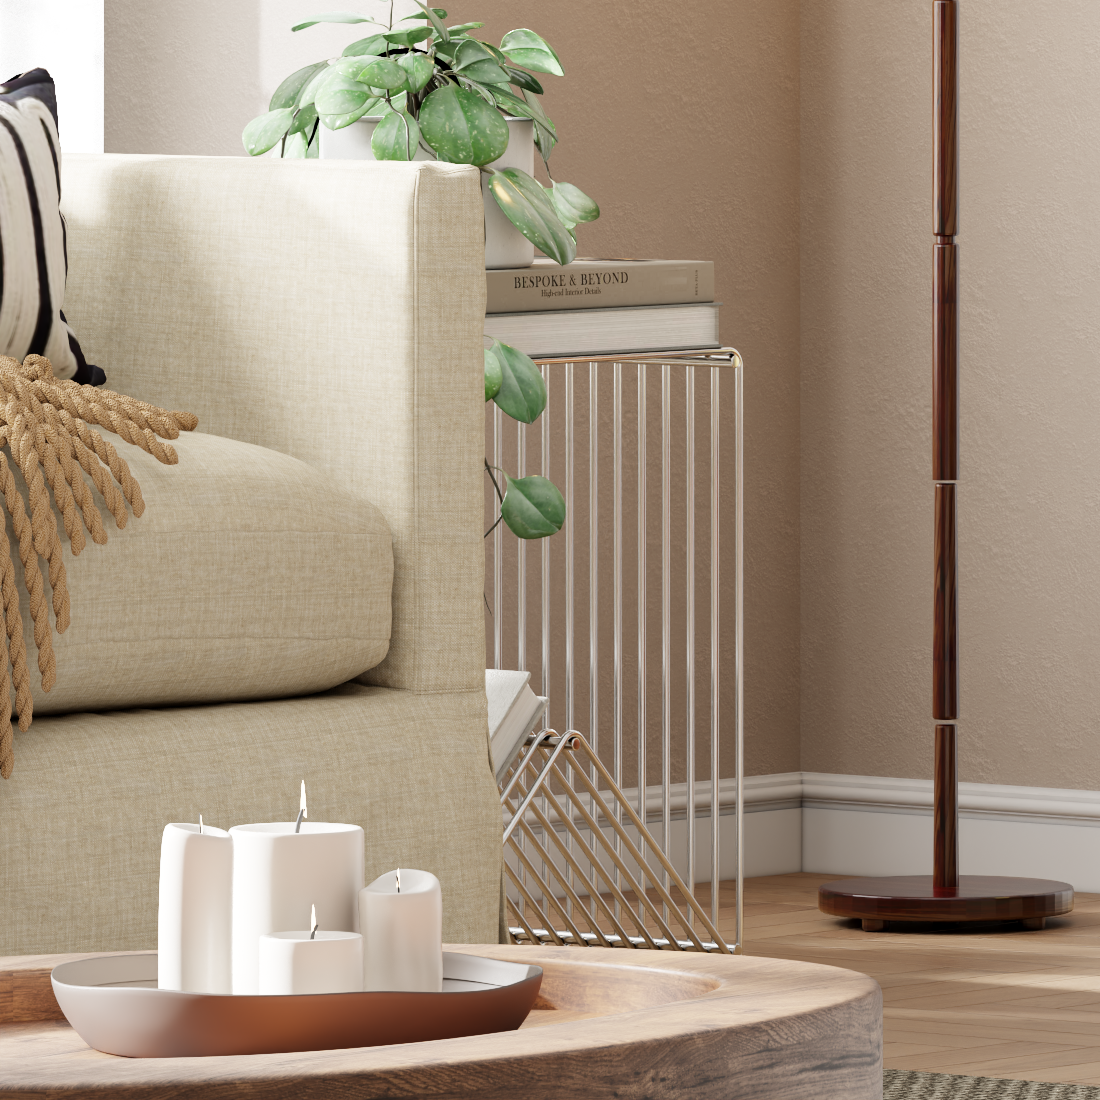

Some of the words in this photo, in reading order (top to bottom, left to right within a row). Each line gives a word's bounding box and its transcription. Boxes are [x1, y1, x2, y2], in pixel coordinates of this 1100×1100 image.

[514, 274, 566, 289] BESPOKE
[569, 276, 577, 287] &
[580, 271, 629, 285] BEYOND
[541, 288, 564, 298] High-end
[565, 287, 584, 297] Interior
[584, 287, 602, 296] Details
